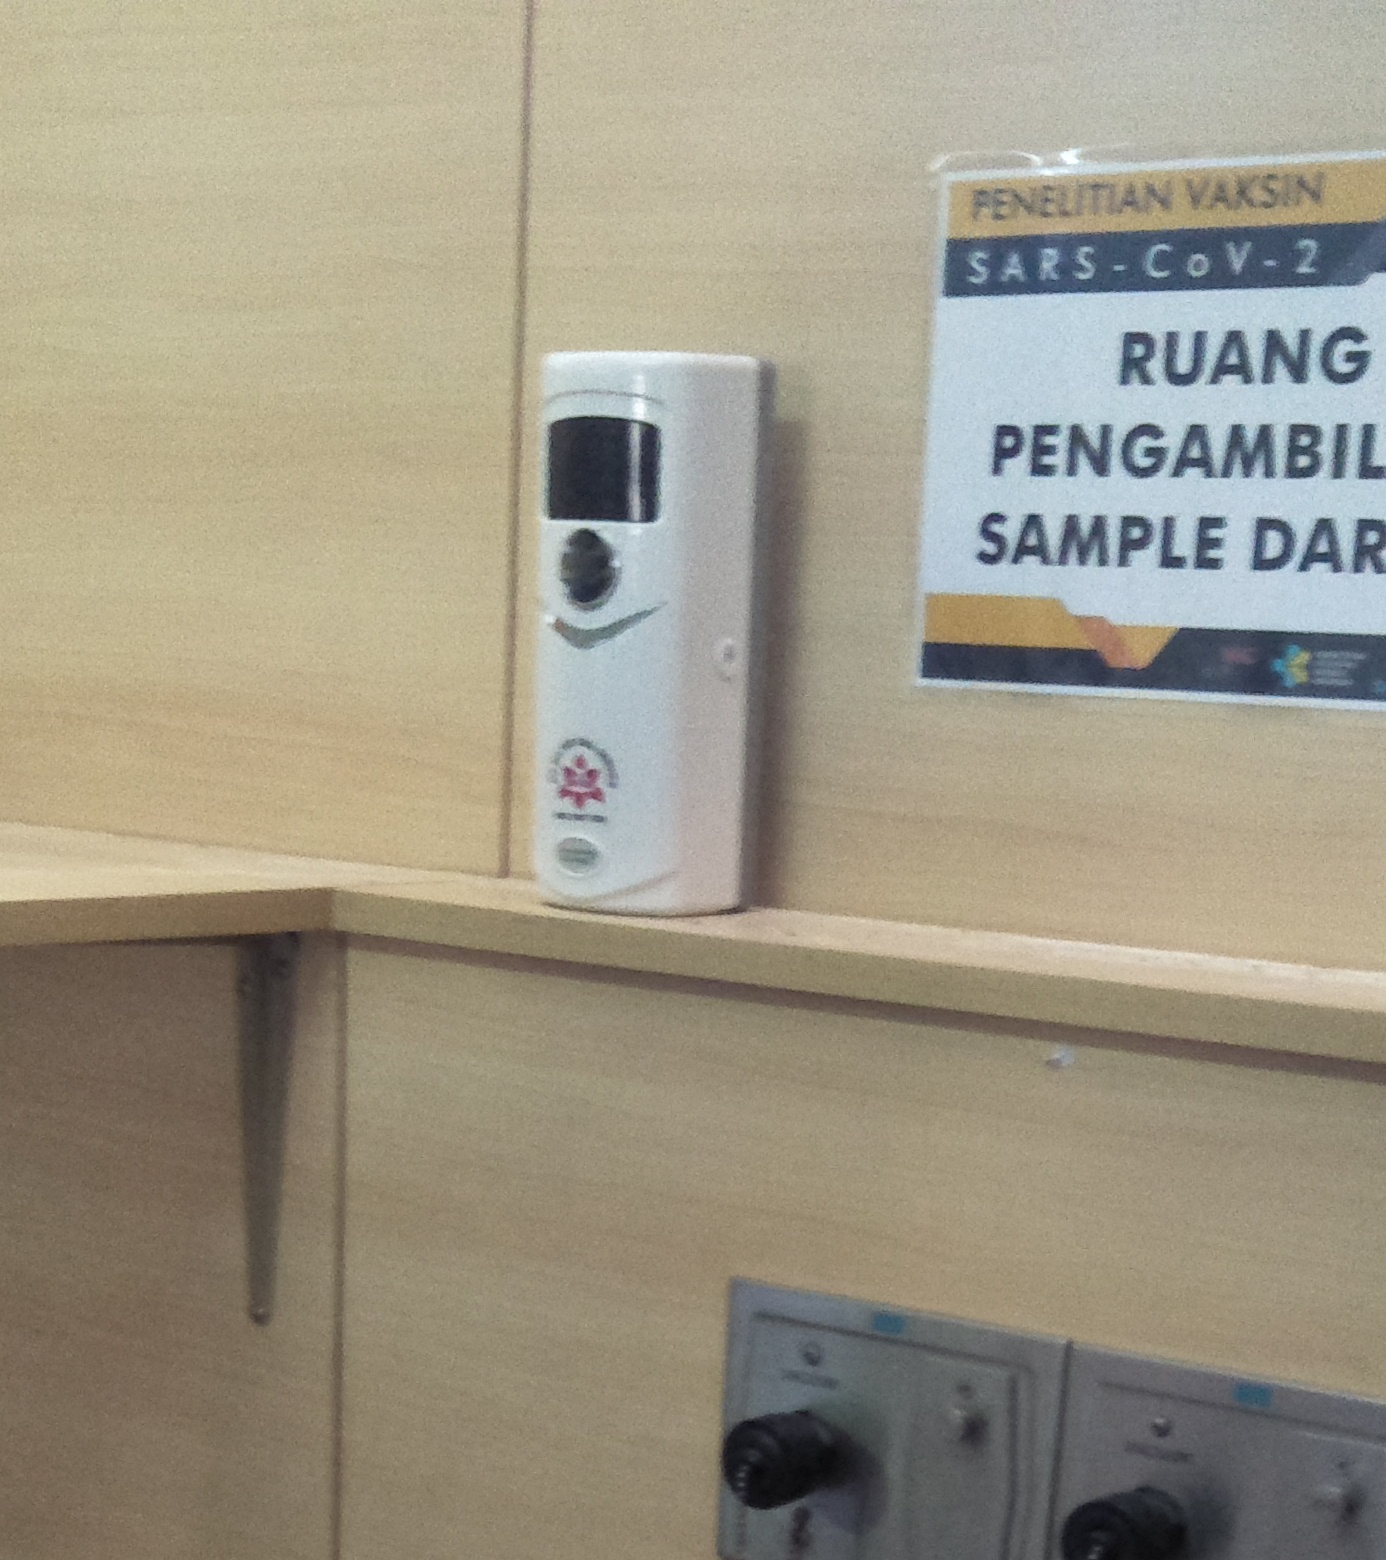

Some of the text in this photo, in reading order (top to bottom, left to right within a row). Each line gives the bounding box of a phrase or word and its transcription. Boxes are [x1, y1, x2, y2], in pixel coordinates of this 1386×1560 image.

[971, 171, 1326, 222] PENELITIAN VAKSIN
[1119, 326, 1373, 387] RUANG
[976, 512, 1228, 571] SAMPLE
